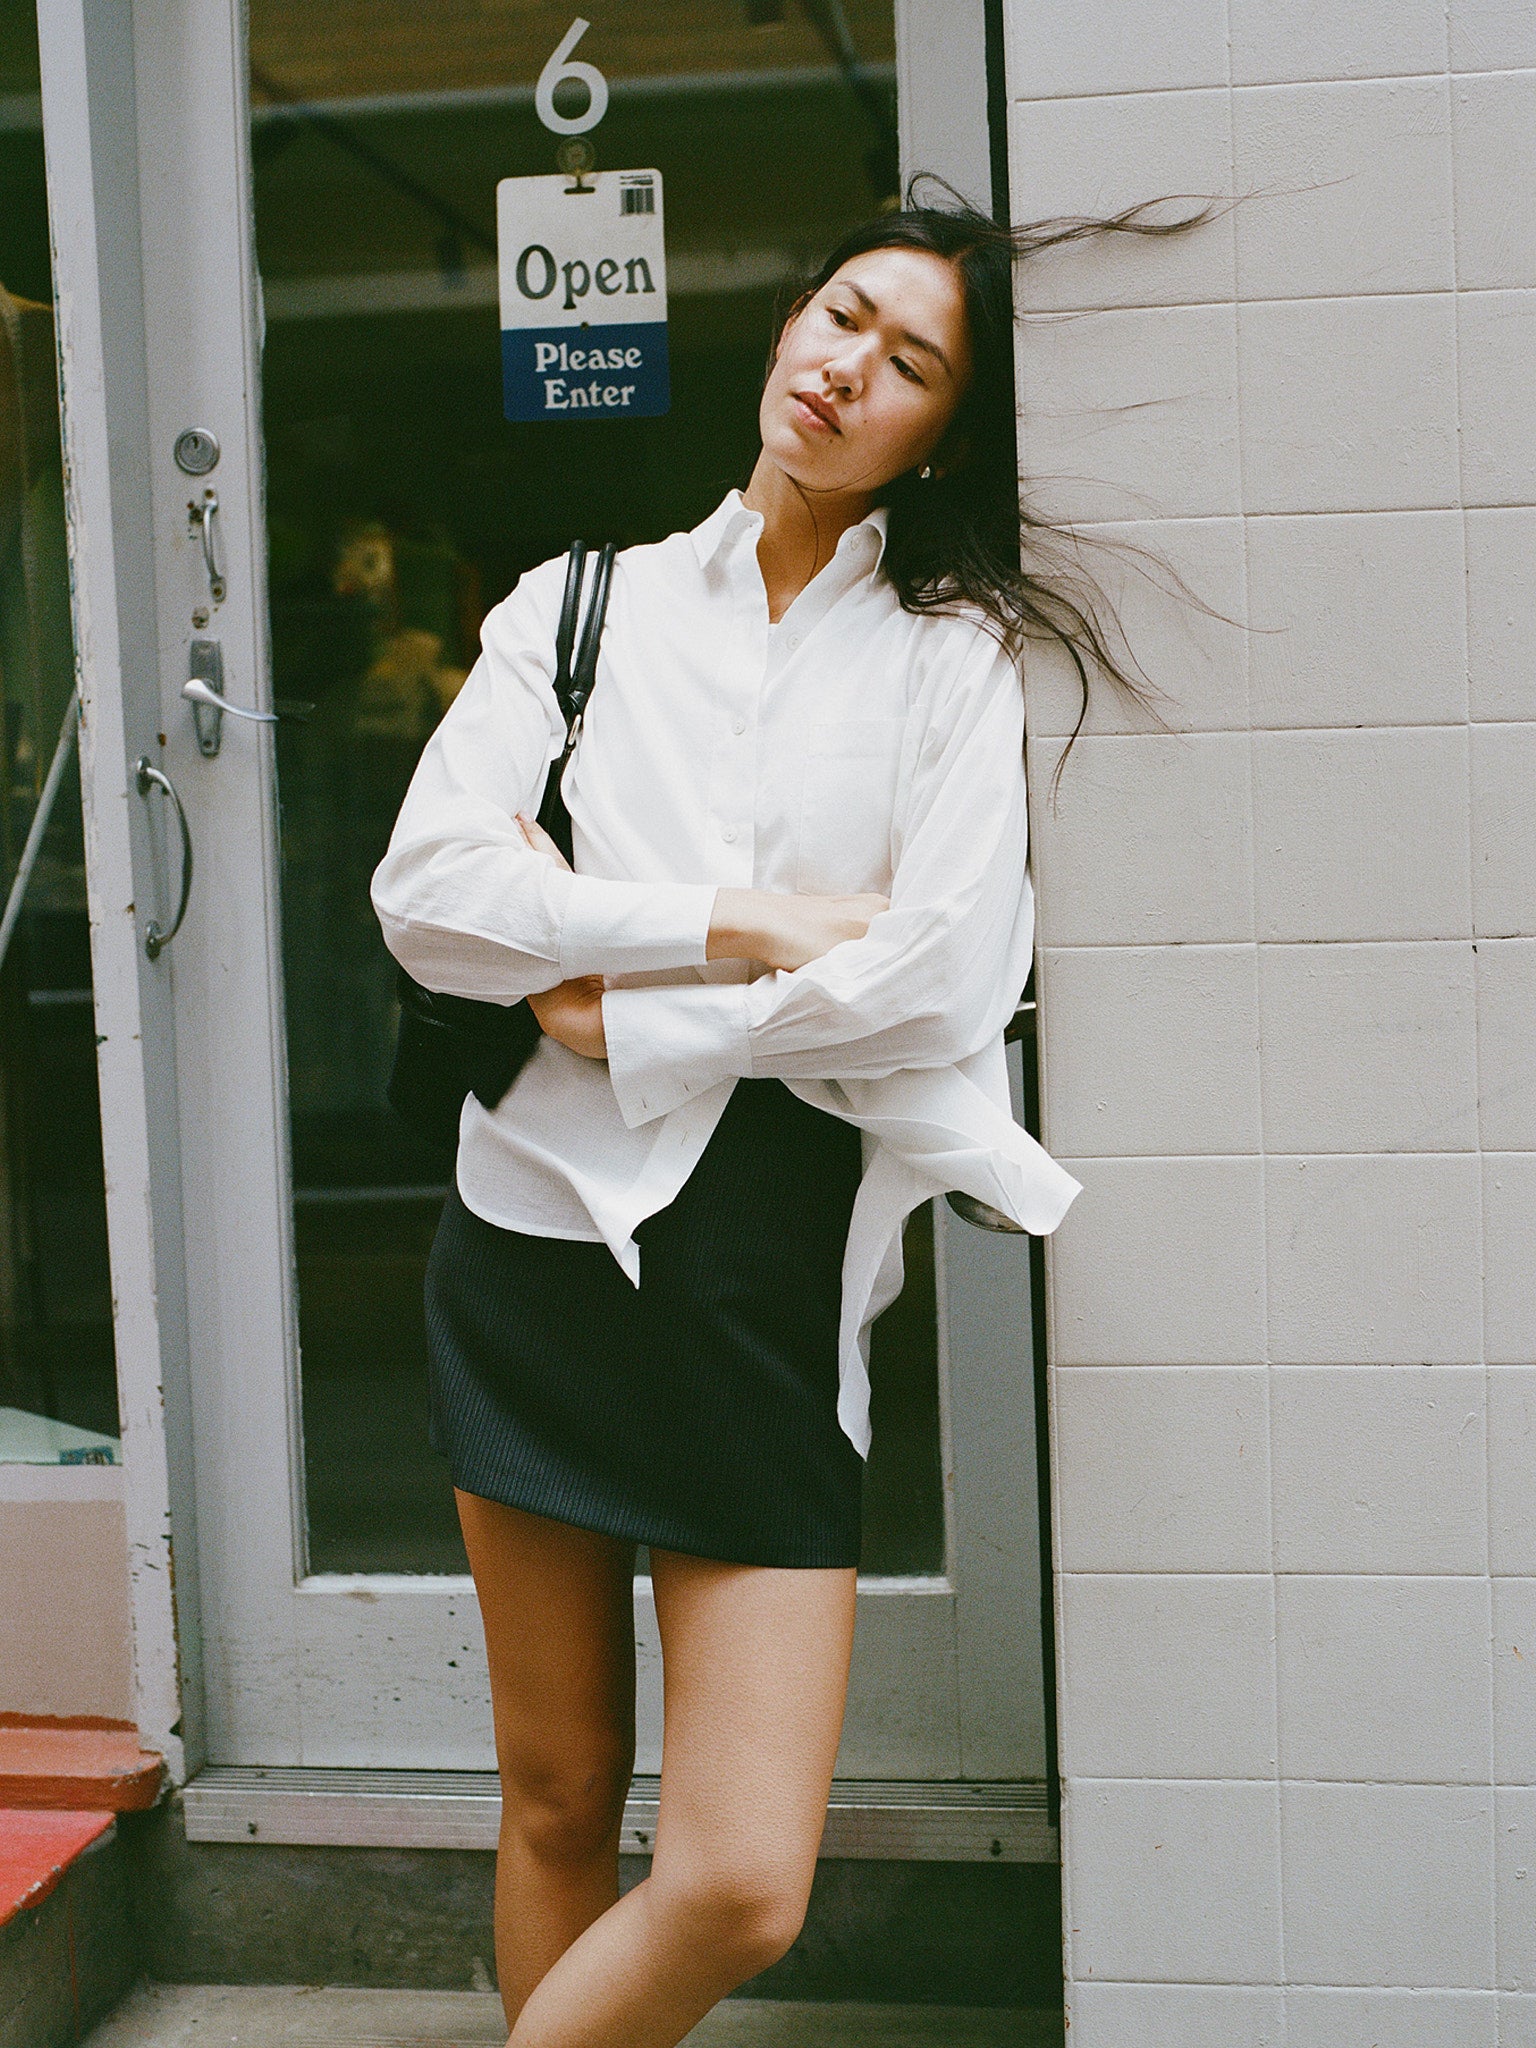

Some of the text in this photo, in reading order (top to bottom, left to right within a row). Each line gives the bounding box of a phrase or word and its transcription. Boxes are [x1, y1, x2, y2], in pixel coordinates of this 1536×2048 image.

[535, 17, 609, 135] 6
[515, 244, 656, 310] Open
[535, 342, 642, 373] Please
[544, 379, 636, 410] Enter
